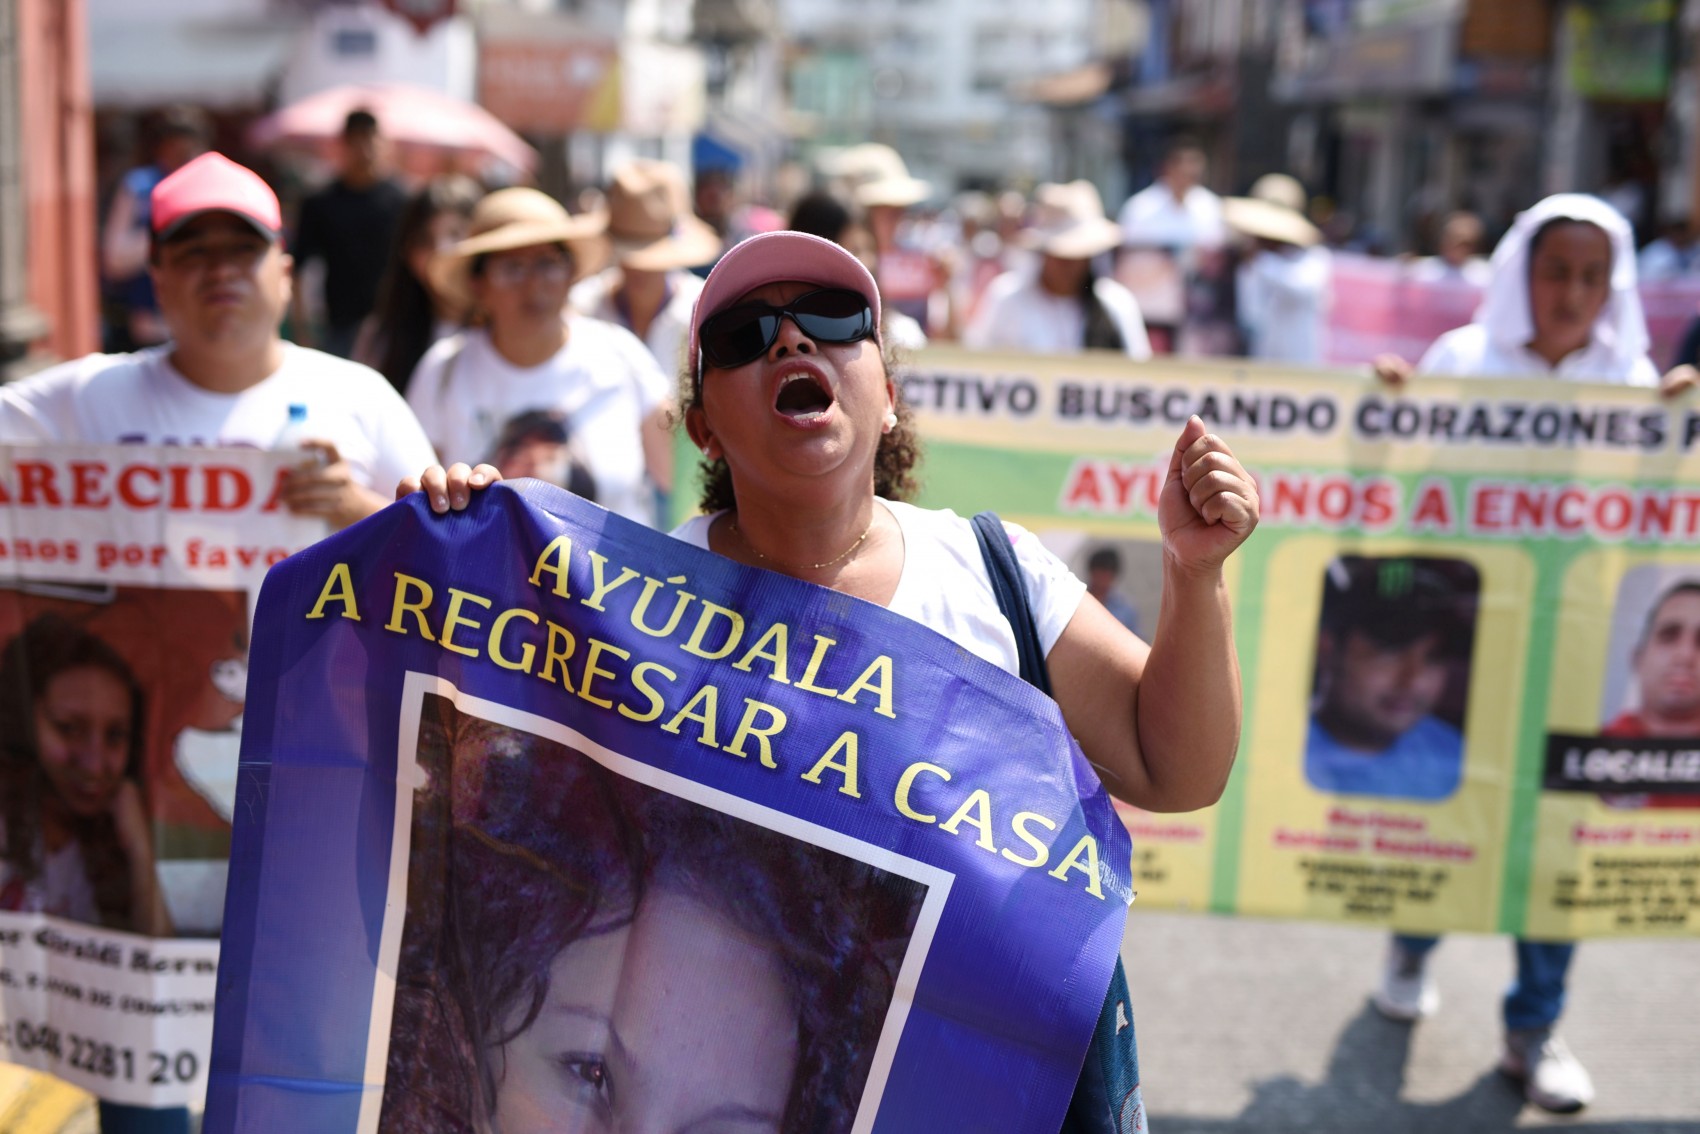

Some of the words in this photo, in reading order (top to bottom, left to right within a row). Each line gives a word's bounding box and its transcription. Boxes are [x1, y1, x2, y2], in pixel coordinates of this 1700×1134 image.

[1058, 380, 1337, 433] BUSCANDO
[1355, 398, 1665, 449] CORAZONES
[0, 461, 291, 513] RECID
[1412, 485, 1451, 531] A
[96, 541, 166, 572] por
[186, 538, 305, 569] favo
[528, 535, 896, 718] AYÚDALA
[305, 563, 361, 621] A
[384, 572, 787, 769] REGRESAR
[802, 731, 863, 798] A
[895, 762, 1106, 901] CASA
[148, 1050, 198, 1083] 20
